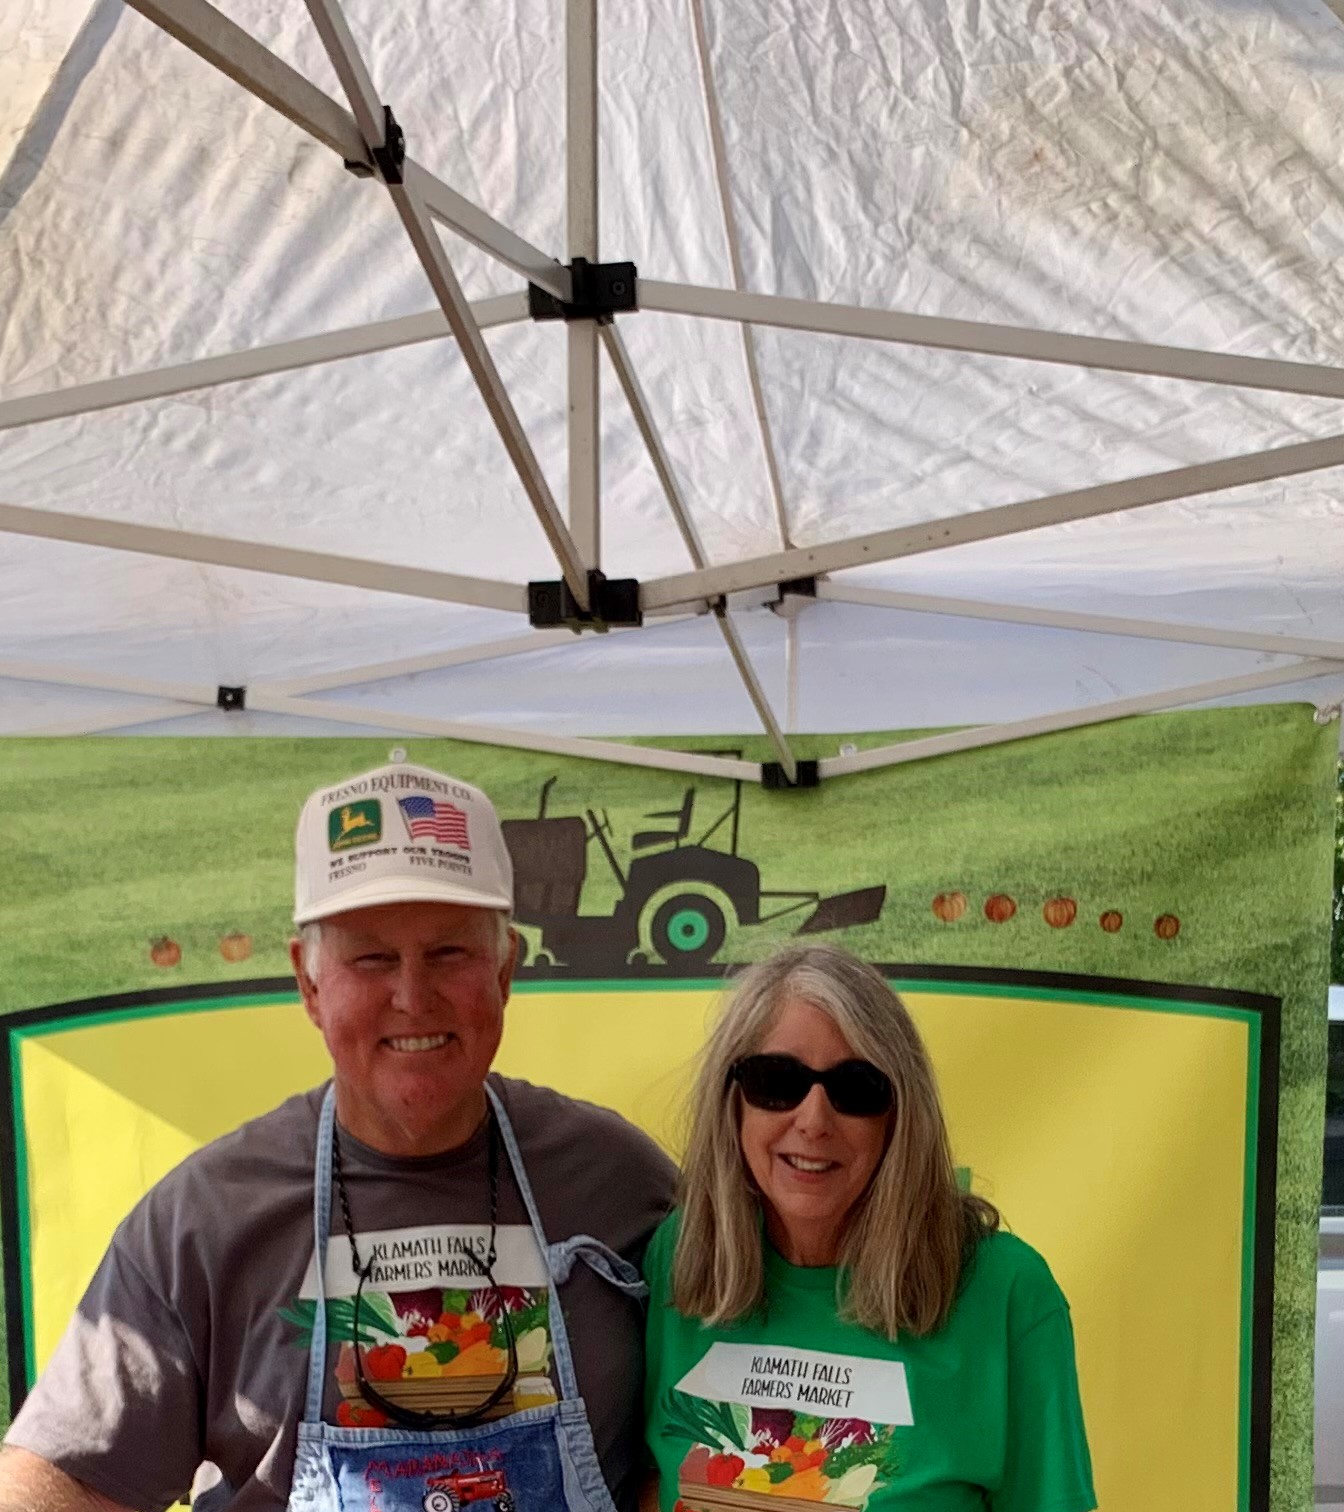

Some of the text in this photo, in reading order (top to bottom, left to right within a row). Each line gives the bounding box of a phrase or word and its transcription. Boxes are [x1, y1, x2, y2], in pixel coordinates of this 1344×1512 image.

[321, 781, 367, 806] FRESNO
[370, 773, 449, 795] EQUIPMENT
[348, 846, 398, 862] SUPPORT
[403, 846, 427, 855] OUR
[431, 847, 471, 864] TROOPS
[409, 856, 472, 876] FIVE POINTS
[329, 862, 367, 883] FRESNO
[372, 1235, 486, 1262] KLAMATH FALLS
[438, 1258, 485, 1278] MARK
[750, 1355, 853, 1385] KLAMATH FALLS
[741, 1377, 855, 1408] FARMERS MARKET
